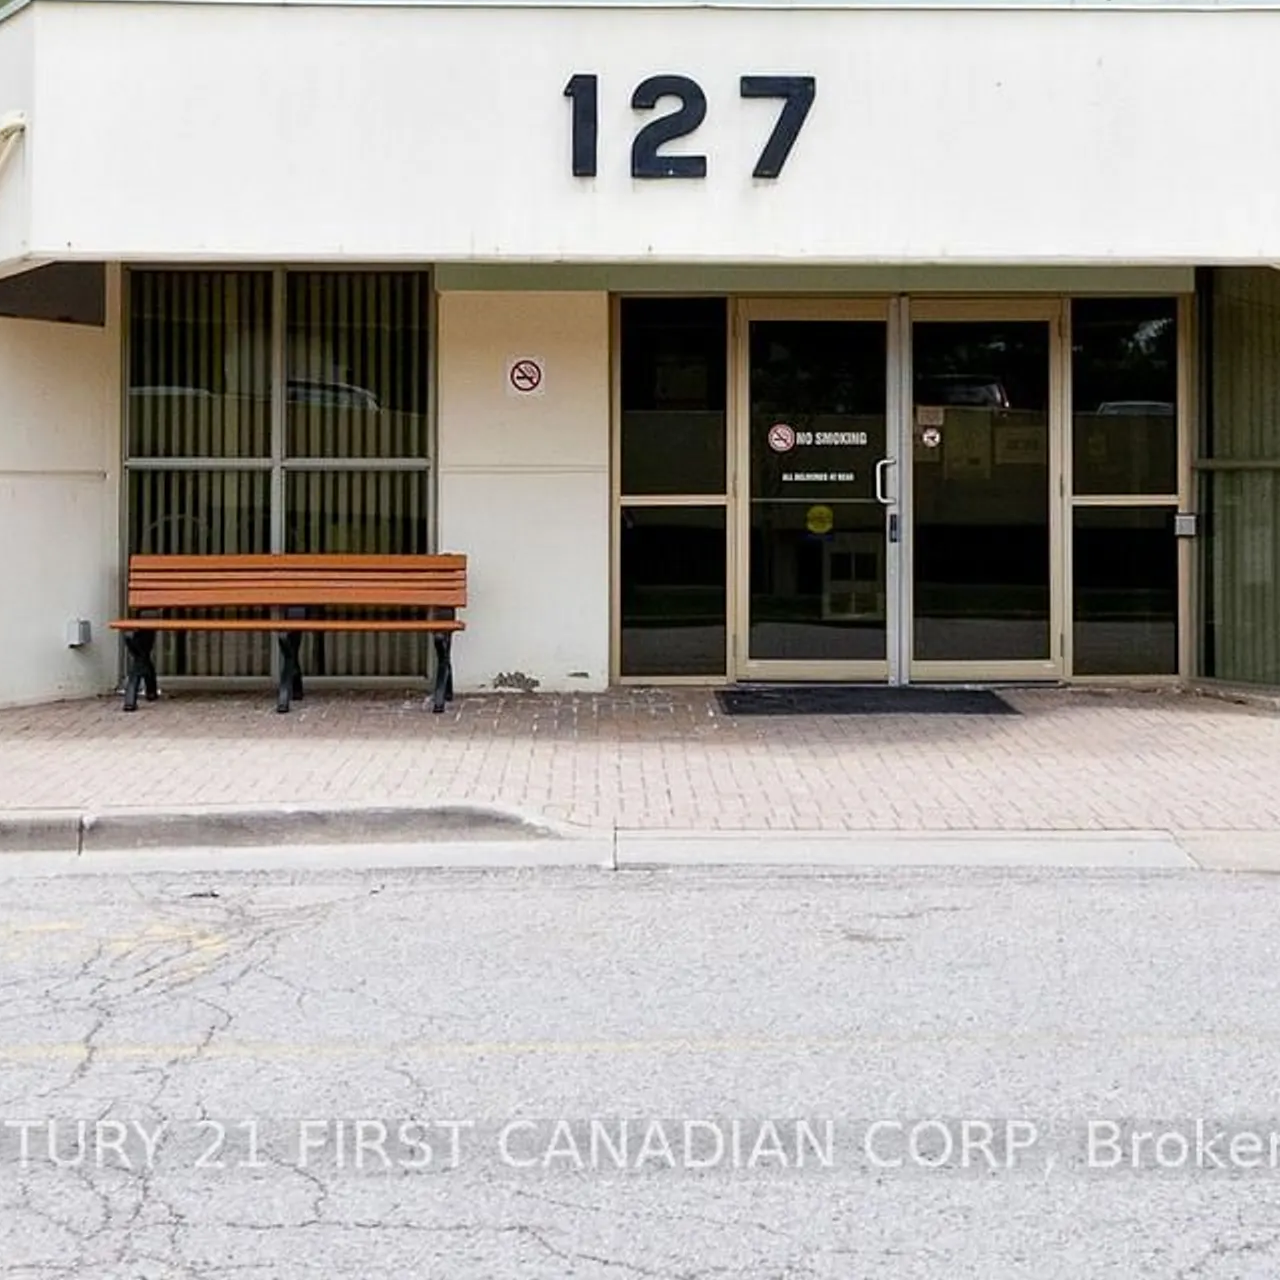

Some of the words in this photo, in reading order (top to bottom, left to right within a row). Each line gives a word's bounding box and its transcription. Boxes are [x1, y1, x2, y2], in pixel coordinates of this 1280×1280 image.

[563, 74, 816, 179] 127
[796, 431, 813, 445] NO
[815, 431, 867, 445] SMOKING
